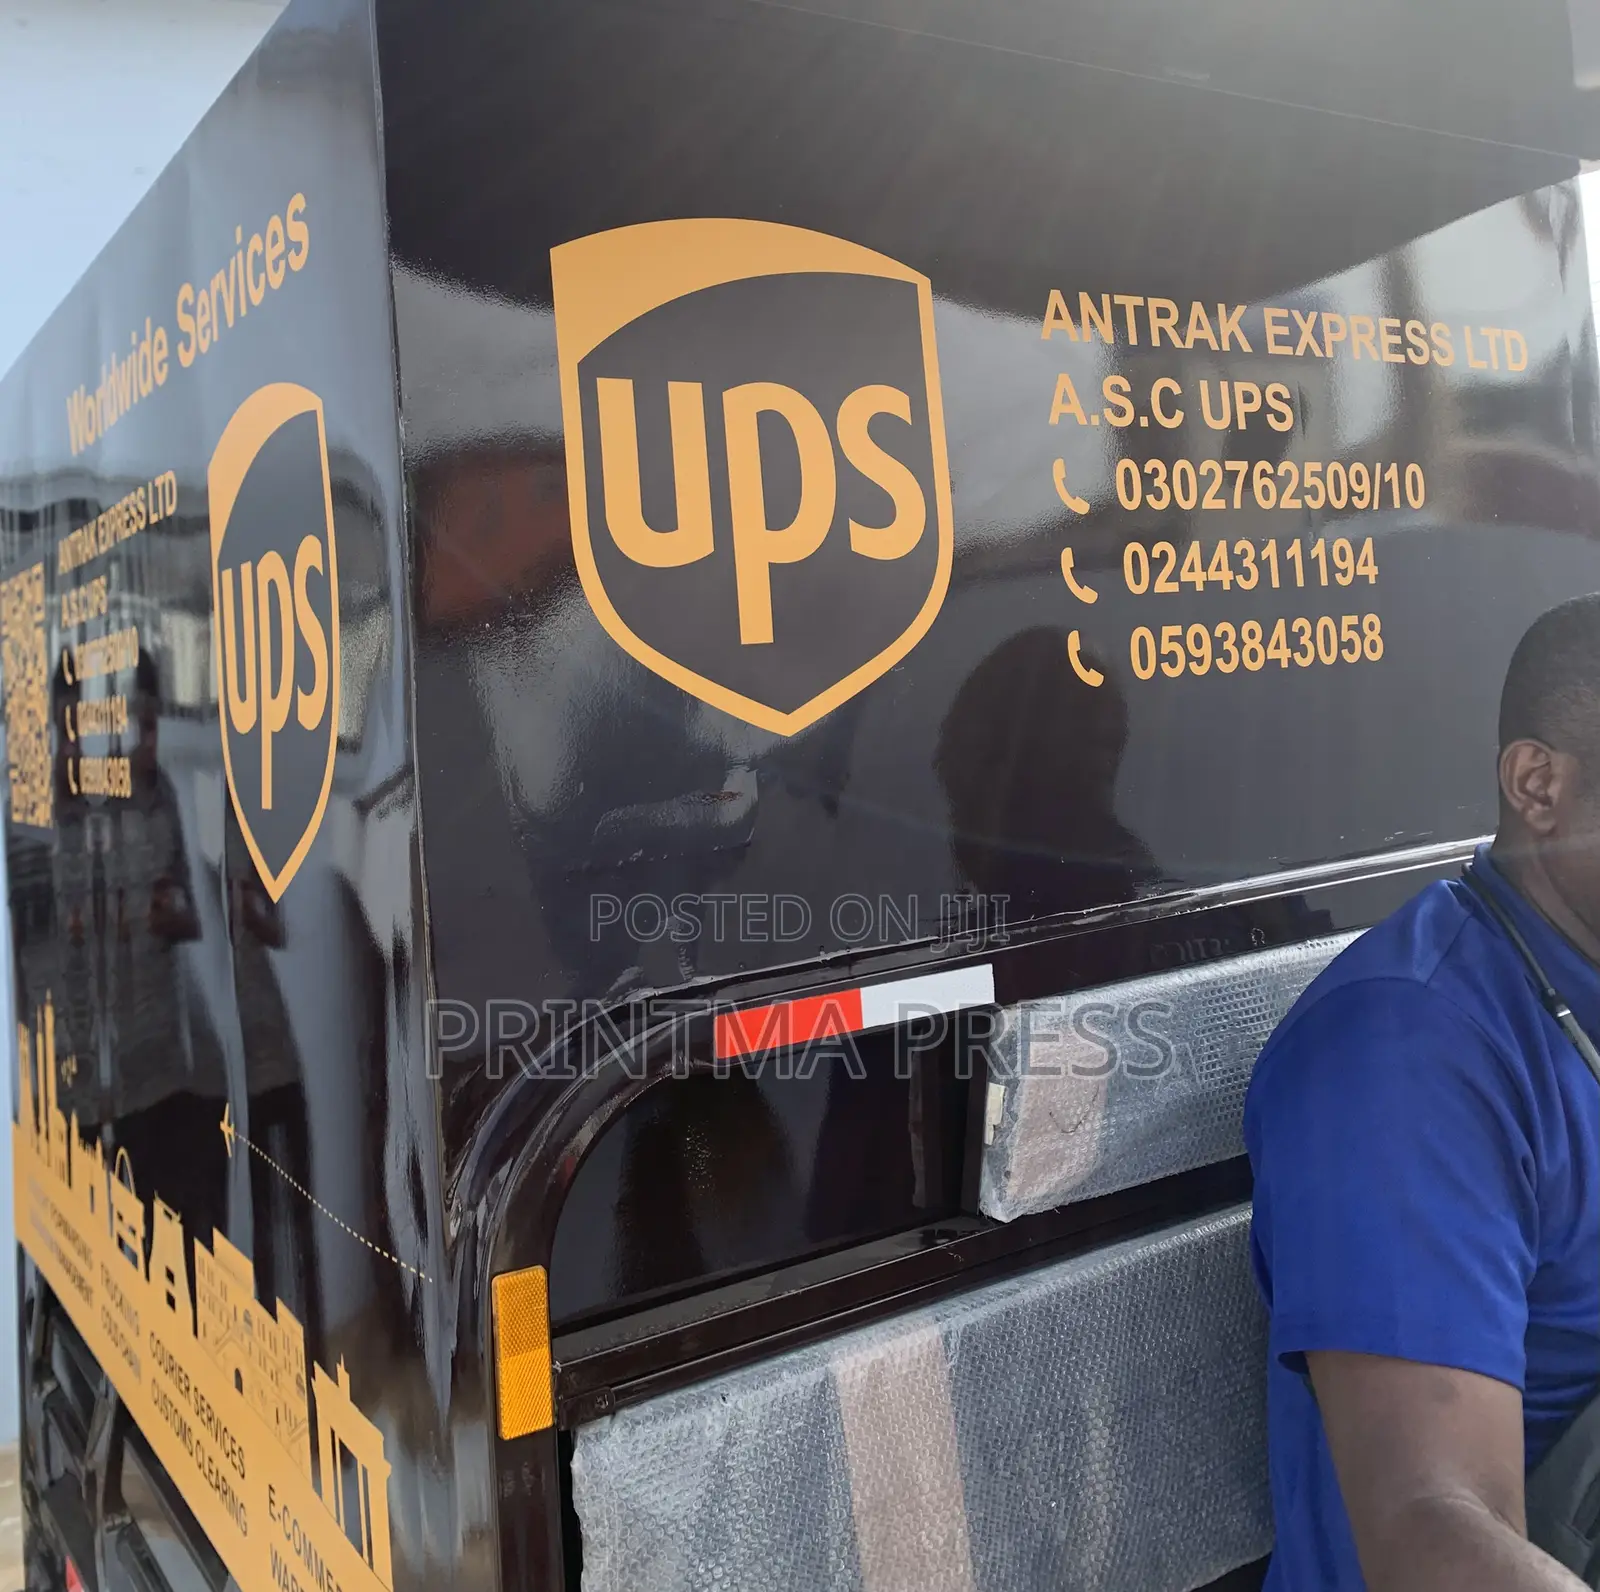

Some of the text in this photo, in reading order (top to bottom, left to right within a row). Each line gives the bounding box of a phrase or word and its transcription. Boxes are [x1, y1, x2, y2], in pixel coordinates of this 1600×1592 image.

[66, 192, 309, 457] Worldwide Services
[1041, 289, 1528, 372] ANTRAK EXPRESS LTD
[1049, 373, 1294, 432] A.S.C UPS
[148, 470, 177, 525] LTD
[1115, 458, 1425, 511] 0302762509/10
[1123, 537, 1378, 595] 0244311194
[1130, 613, 1384, 680] 0593843058
[150, 1331, 246, 1480] COURIER SERVICES
[151, 1378, 248, 1538] CUSTOMS CLEARING
